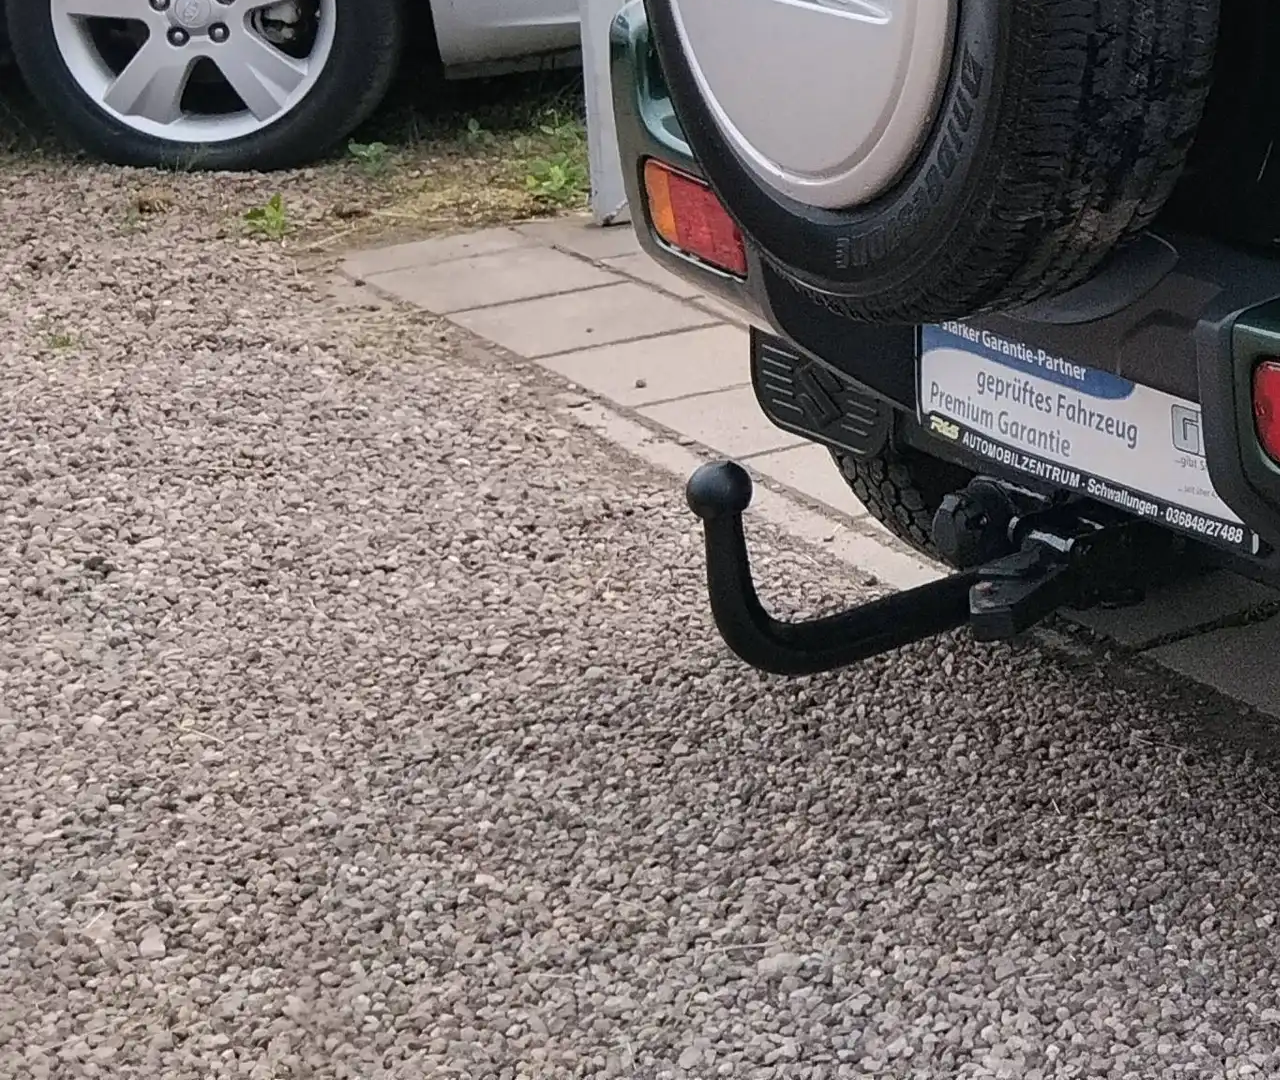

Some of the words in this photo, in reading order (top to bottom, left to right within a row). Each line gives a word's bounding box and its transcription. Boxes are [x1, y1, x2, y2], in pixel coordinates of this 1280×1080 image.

[982, 330, 1087, 381] Garantie-Partner
[930, 381, 994, 431] Premium
[999, 410, 1072, 458] Garantie
[976, 370, 1053, 414] geprüftes
[1056, 394, 1138, 450] Fahrzeug
[962, 431, 1080, 488] AUTOMOBILZENTRUM
[1087, 477, 1159, 516] Schwallungen
[1166, 506, 1244, 544] 036848/27488
